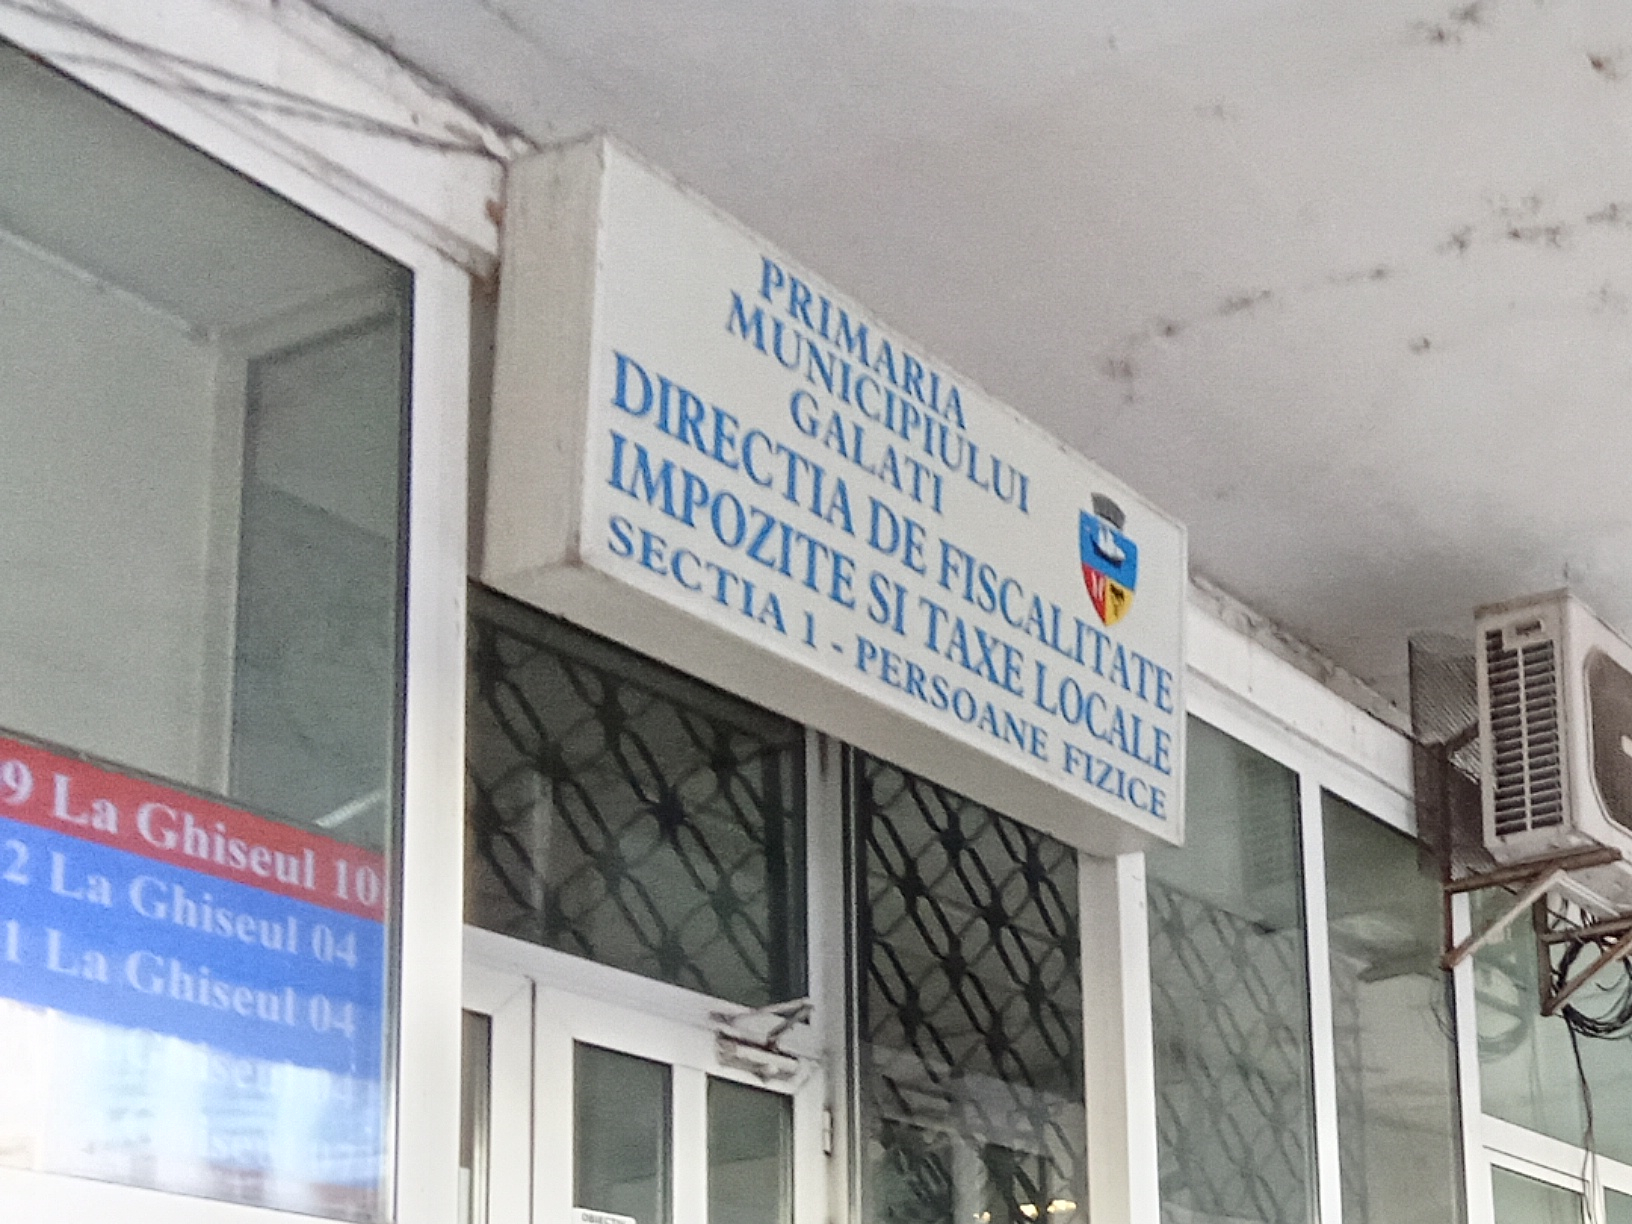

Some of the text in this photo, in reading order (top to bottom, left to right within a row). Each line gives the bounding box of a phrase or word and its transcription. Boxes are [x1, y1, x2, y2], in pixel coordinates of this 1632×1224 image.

[726, 291, 1029, 513] MUNICIPIULUI
[760, 258, 967, 430] PRIMARIA
[611, 351, 1174, 714] DIRECTIA DE FISCALITATE
[789, 389, 944, 514] GALATI
[608, 431, 1172, 776] IMPOZITE SI TAXE LOCALE
[608, 516, 787, 636] SECTIA
[803, 610, 818, 651] 1
[856, 635, 1047, 761] PERSOANE
[1063, 741, 1167, 819] FIZICE
[2, 839, 360, 970] 2 La Ghiseul 04
[53, 773, 119, 835] La
[136, 800, 317, 891] Ghiseul
[334, 859, 382, 907] 10
[46, 927, 109, 984] La
[125, 949, 297, 1027] Ghiseul
[308, 993, 357, 1041] 04
